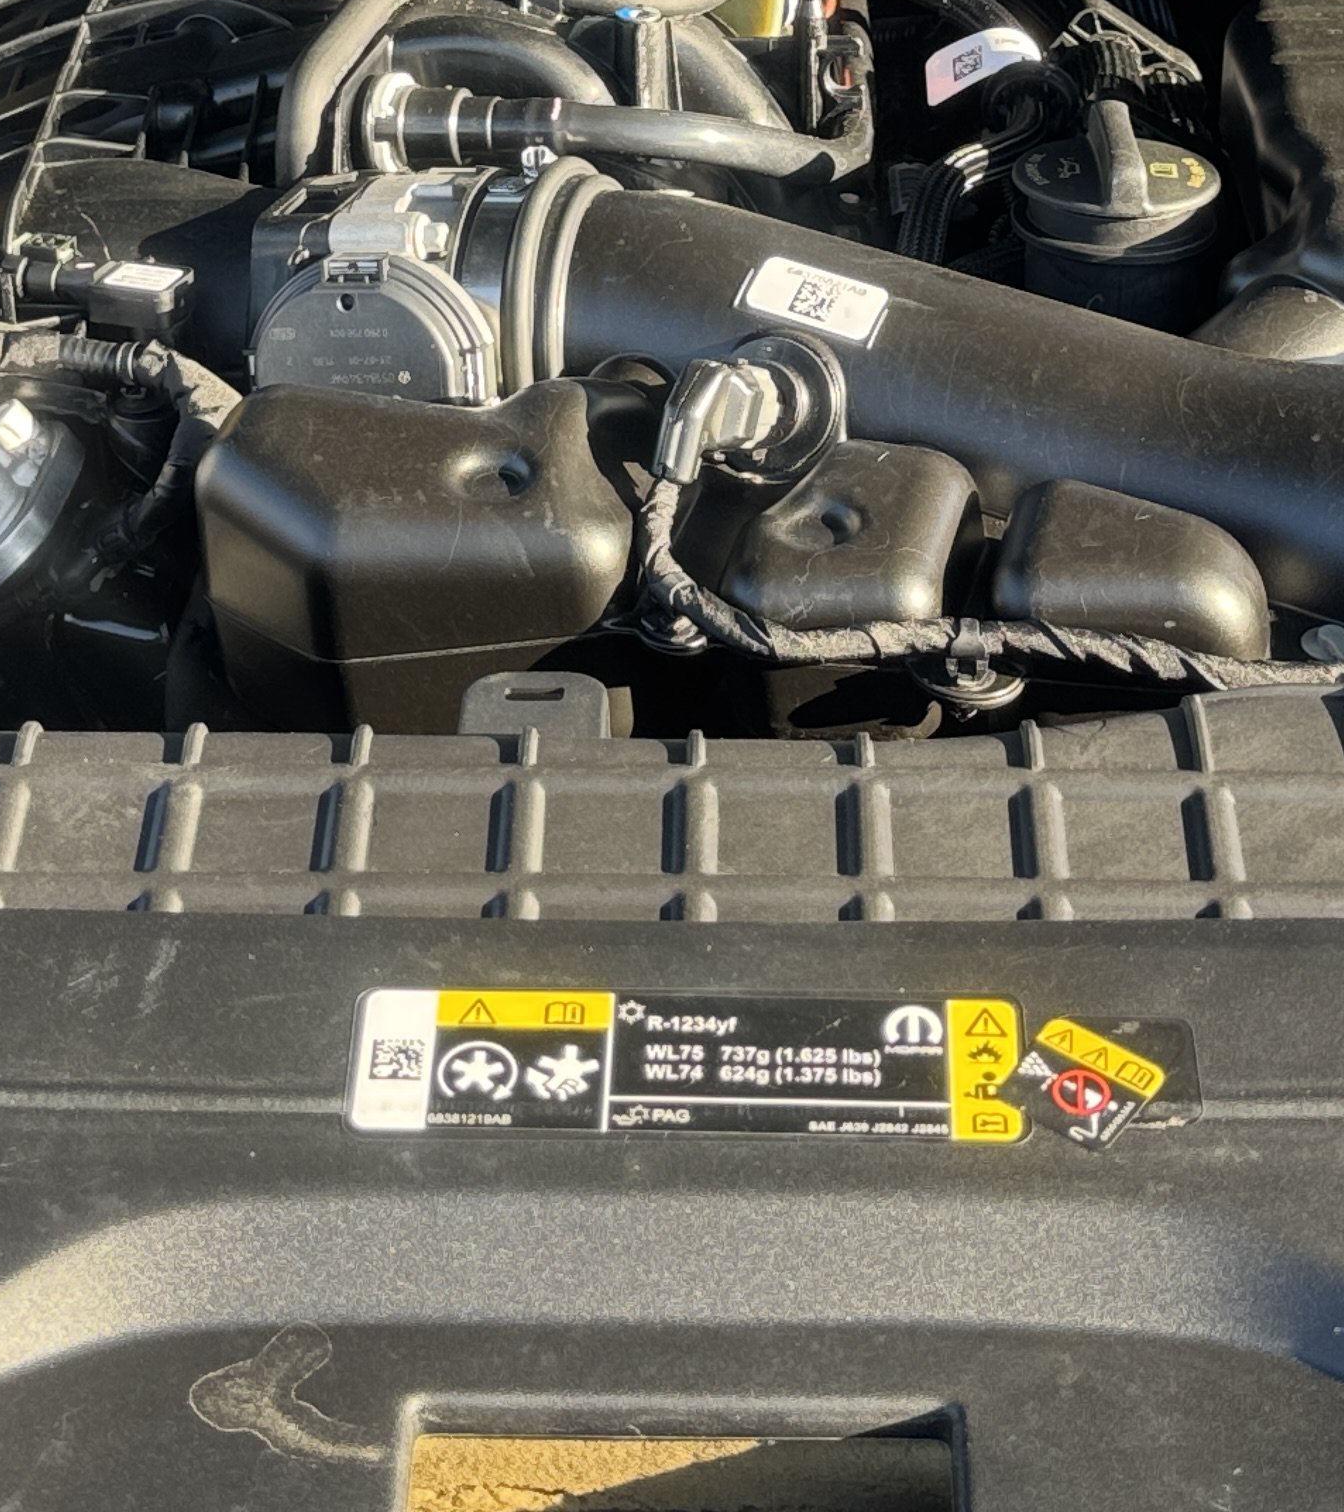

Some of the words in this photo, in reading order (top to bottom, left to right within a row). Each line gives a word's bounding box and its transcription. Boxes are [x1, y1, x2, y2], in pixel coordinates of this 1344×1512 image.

[647, 1015, 738, 1037] R-1234yf
[645, 1044, 705, 1062] WL75
[720, 1046, 770, 1066] 737g
[775, 1046, 838, 1066] (1.625
[841, 1047, 882, 1068] lbs)
[644, 1063, 704, 1080] WL74
[719, 1065, 770, 1086] 624g
[775, 1065, 838, 1085] (1.375
[841, 1067, 882, 1088] lbs)
[651, 1108, 692, 1123] PAG
[808, 1121, 837, 1133] SAE
